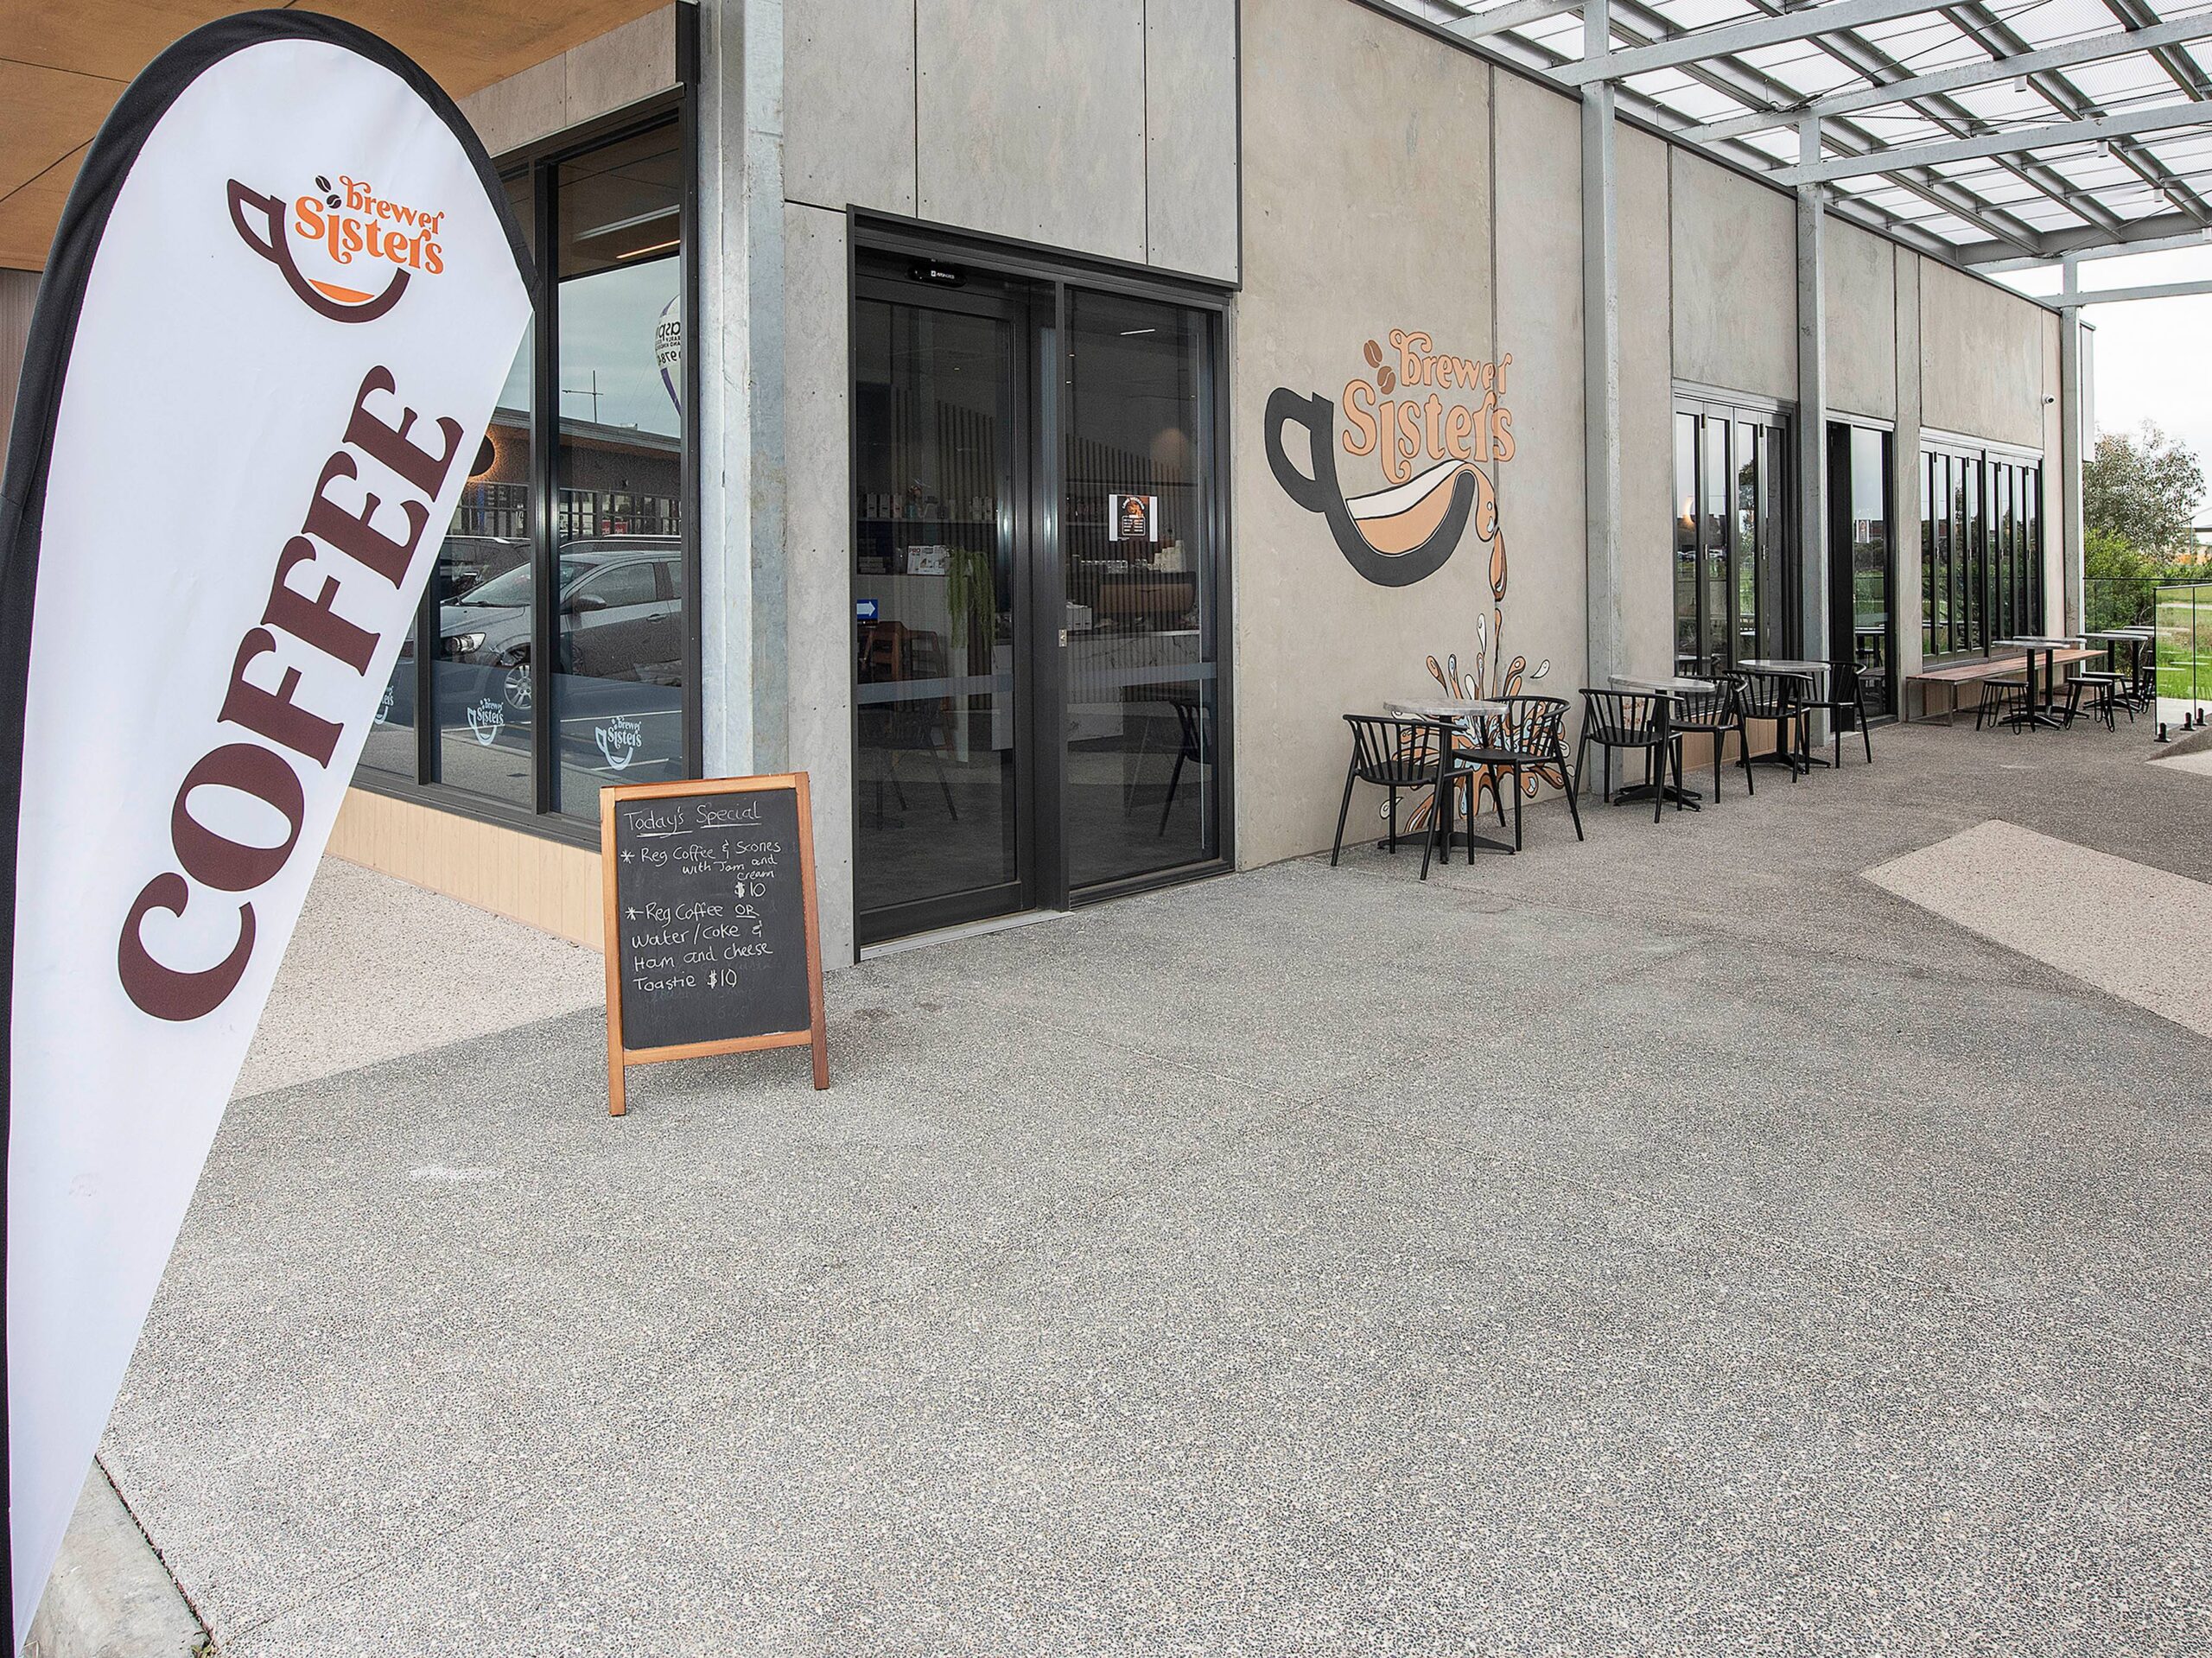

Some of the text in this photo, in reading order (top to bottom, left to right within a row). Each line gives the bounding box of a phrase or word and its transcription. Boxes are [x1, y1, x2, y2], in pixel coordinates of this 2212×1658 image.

[339, 175, 445, 234] brewer
[295, 196, 444, 275] Sisters
[1389, 328, 1512, 394] brewer
[1342, 378, 1516, 484] Sisters
[117, 365, 464, 1021] COFFEE
[477, 707, 504, 726] Sisters
[607, 727, 642, 749] Sisters
[624, 800, 762, 838] Today's Special
[641, 848, 667, 867] Reg
[672, 844, 716, 861] Coffee
[735, 841, 782, 854] Scones
[682, 854, 779, 874] with Jam and
[737, 869, 775, 880] cream
[645, 902, 760, 928] Reg Coffee OR
[633, 956, 675, 972] Ham
[683, 947, 718, 963] and
[632, 969, 737, 991] Toastie $10
